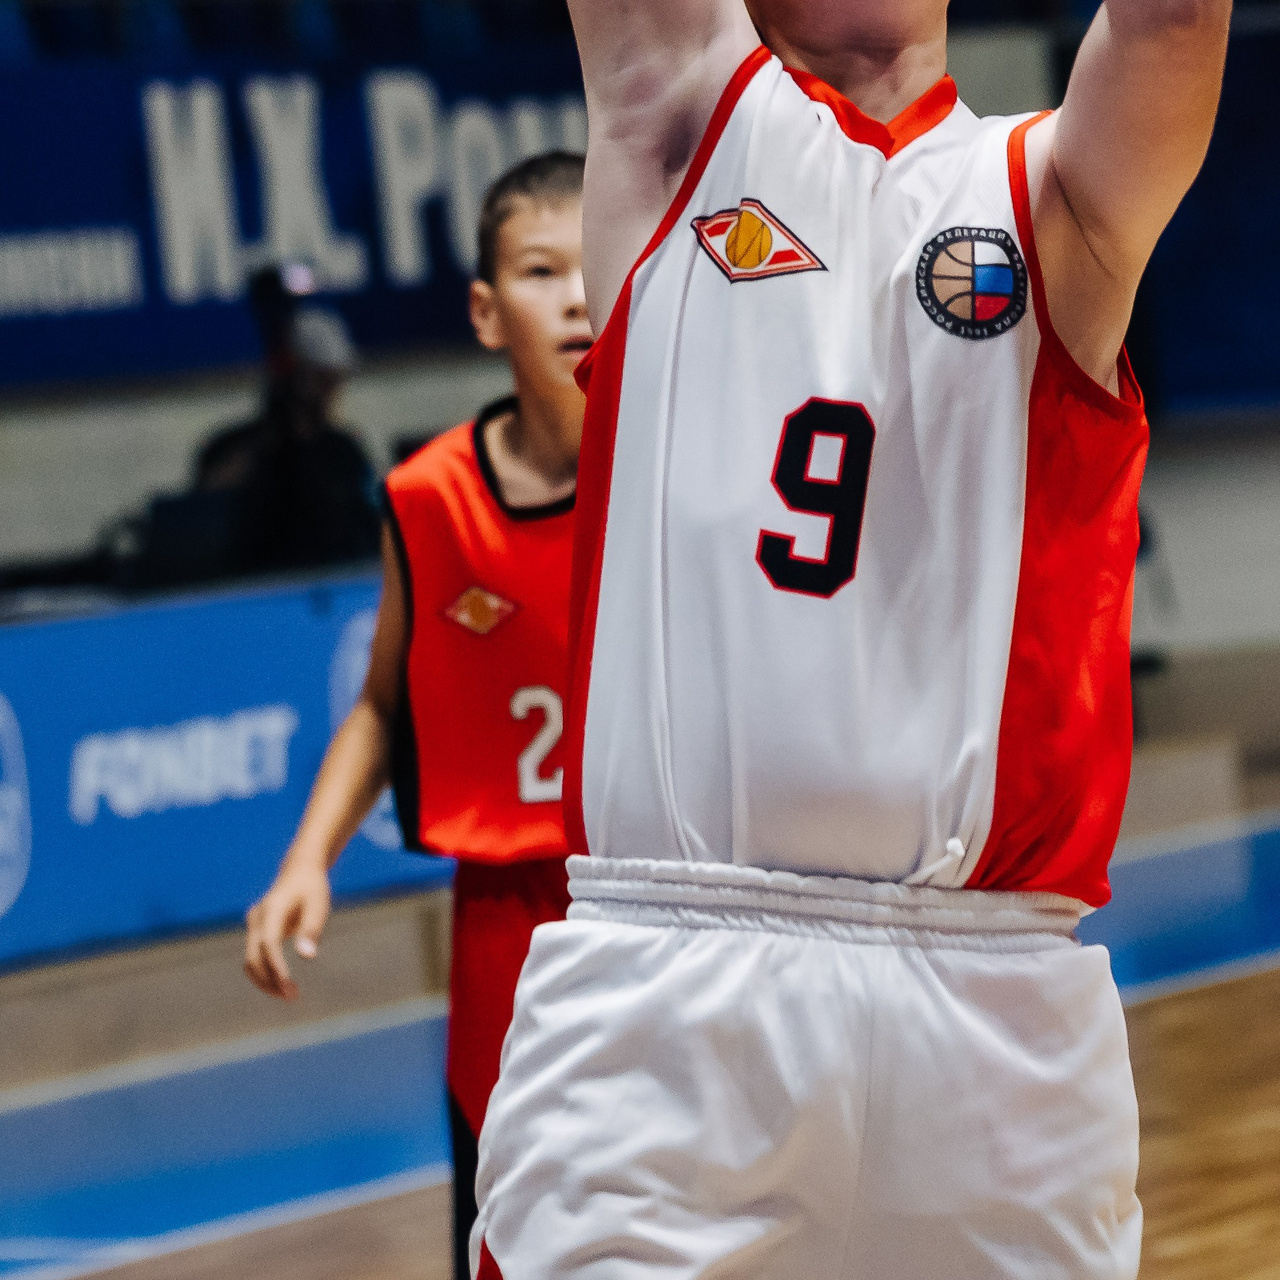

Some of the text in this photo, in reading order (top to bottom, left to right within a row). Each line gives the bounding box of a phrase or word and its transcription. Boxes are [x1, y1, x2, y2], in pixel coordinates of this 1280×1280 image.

[364, 67, 588, 286] Ро
[755, 396, 876, 599] 9
[69, 704, 299, 824] FONBET
